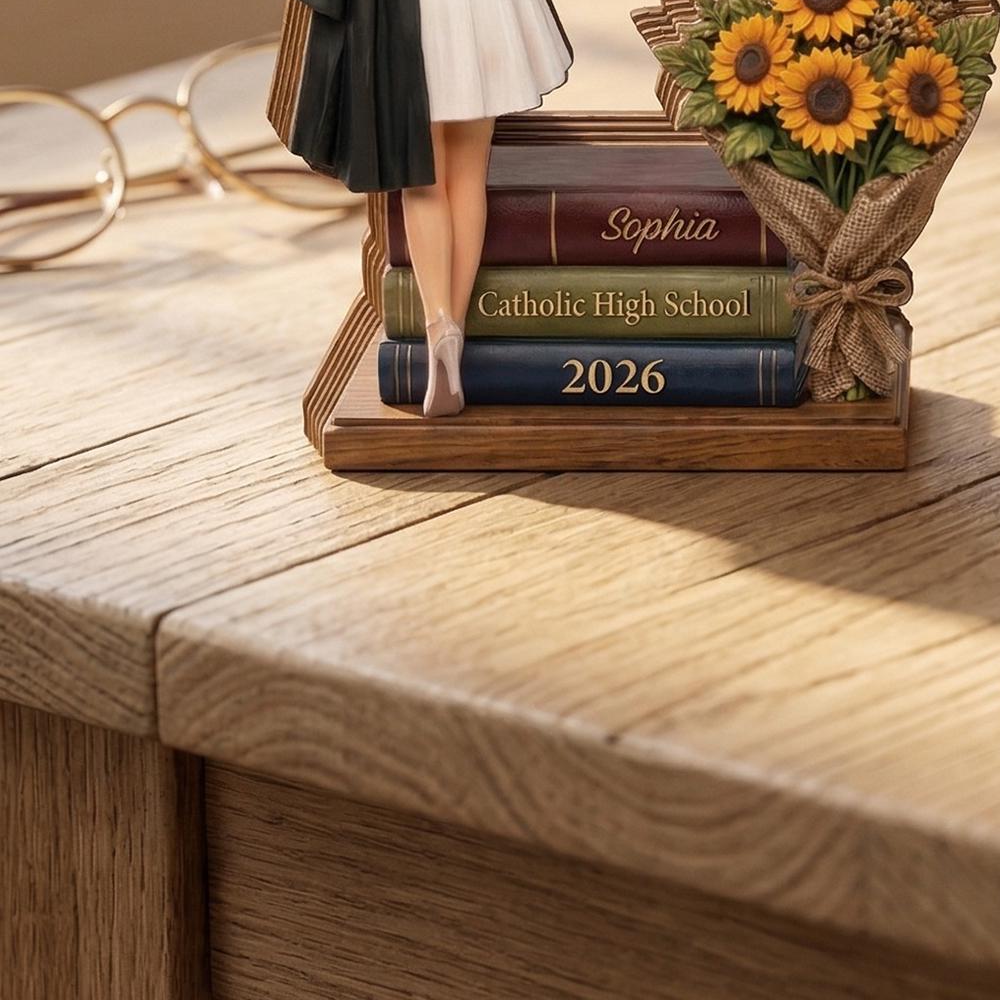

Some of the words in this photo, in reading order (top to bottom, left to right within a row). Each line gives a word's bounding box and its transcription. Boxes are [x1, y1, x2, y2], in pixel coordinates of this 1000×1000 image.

[601, 207, 720, 254] Sophia
[478, 291, 586, 317] Catholic
[593, 291, 657, 325] High
[664, 291, 751, 317] School
[562, 359, 666, 394] 2026
